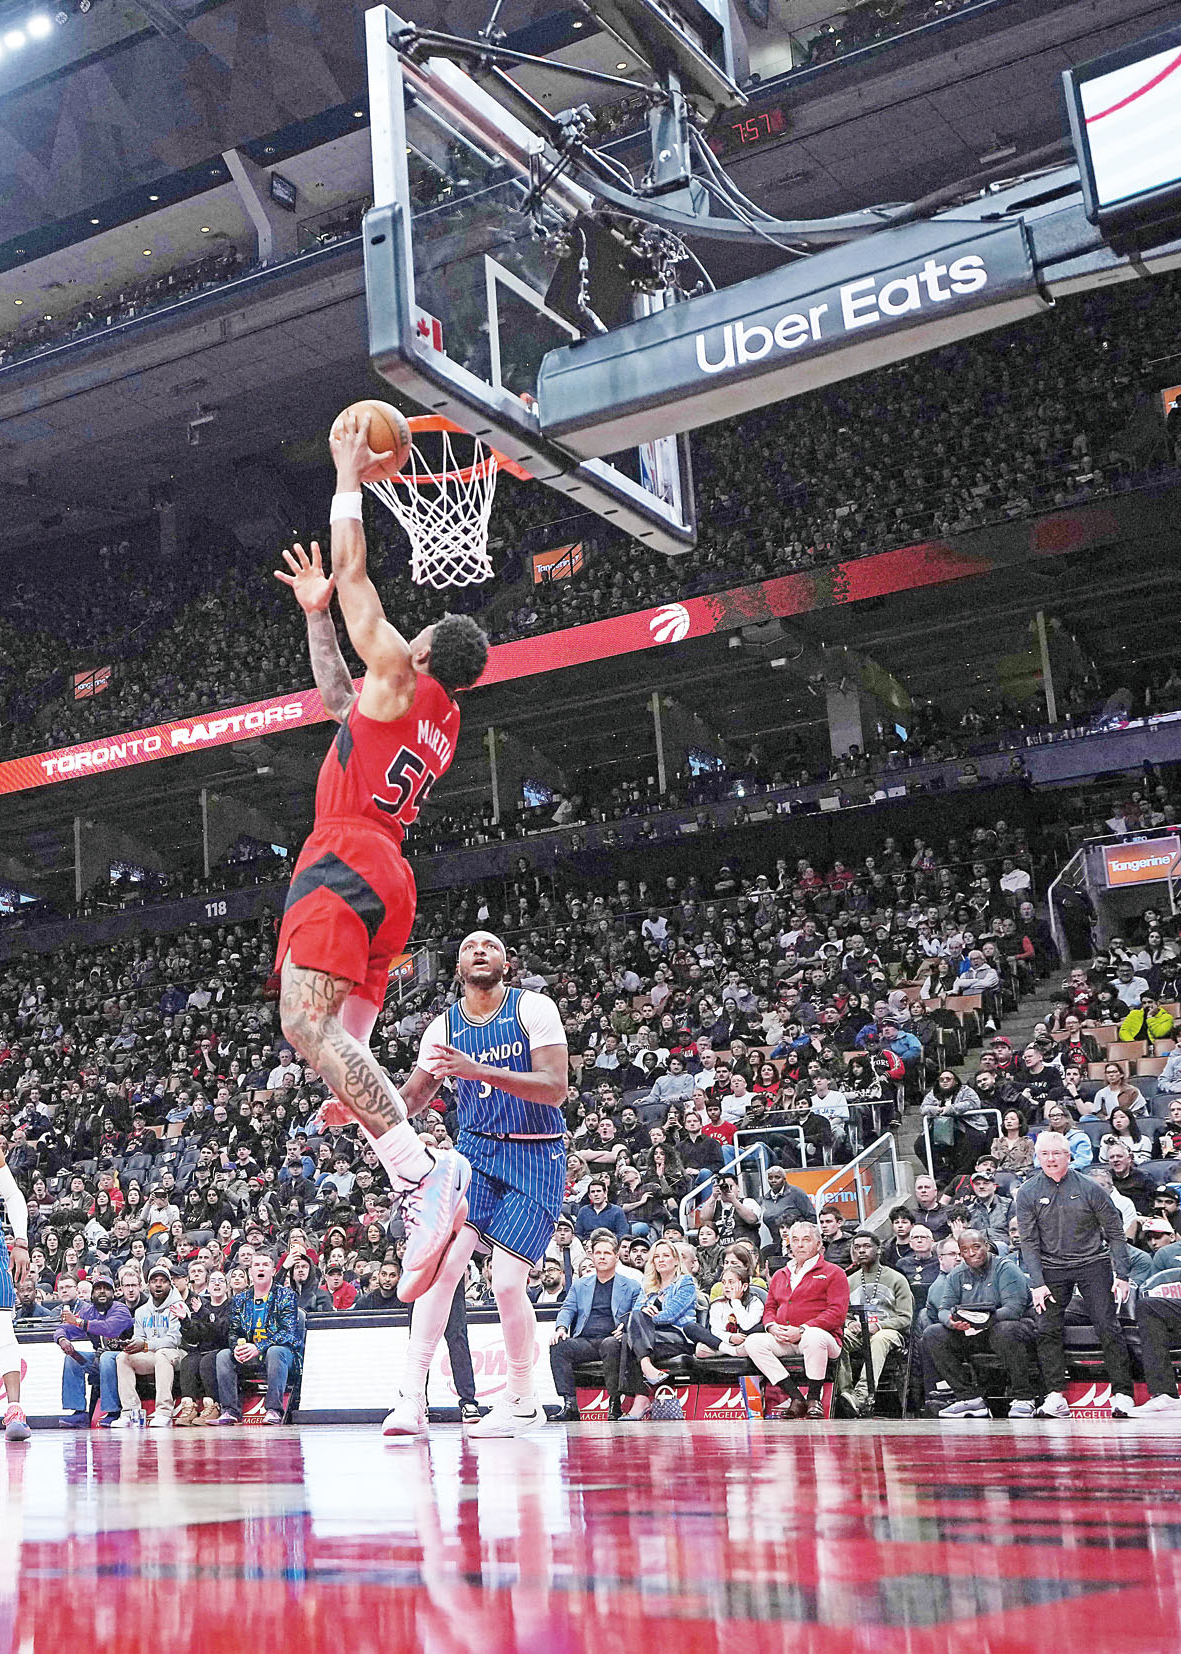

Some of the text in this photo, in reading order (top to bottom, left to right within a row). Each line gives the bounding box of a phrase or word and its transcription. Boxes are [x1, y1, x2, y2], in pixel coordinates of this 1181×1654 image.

[731, 113, 772, 144] 7:57
[695, 254, 988, 374] Uber Eats
[41, 701, 303, 777] TORONTO RAPTORS
[1108, 854, 1171, 872] Tangerine
[204, 900, 227, 918] 118
